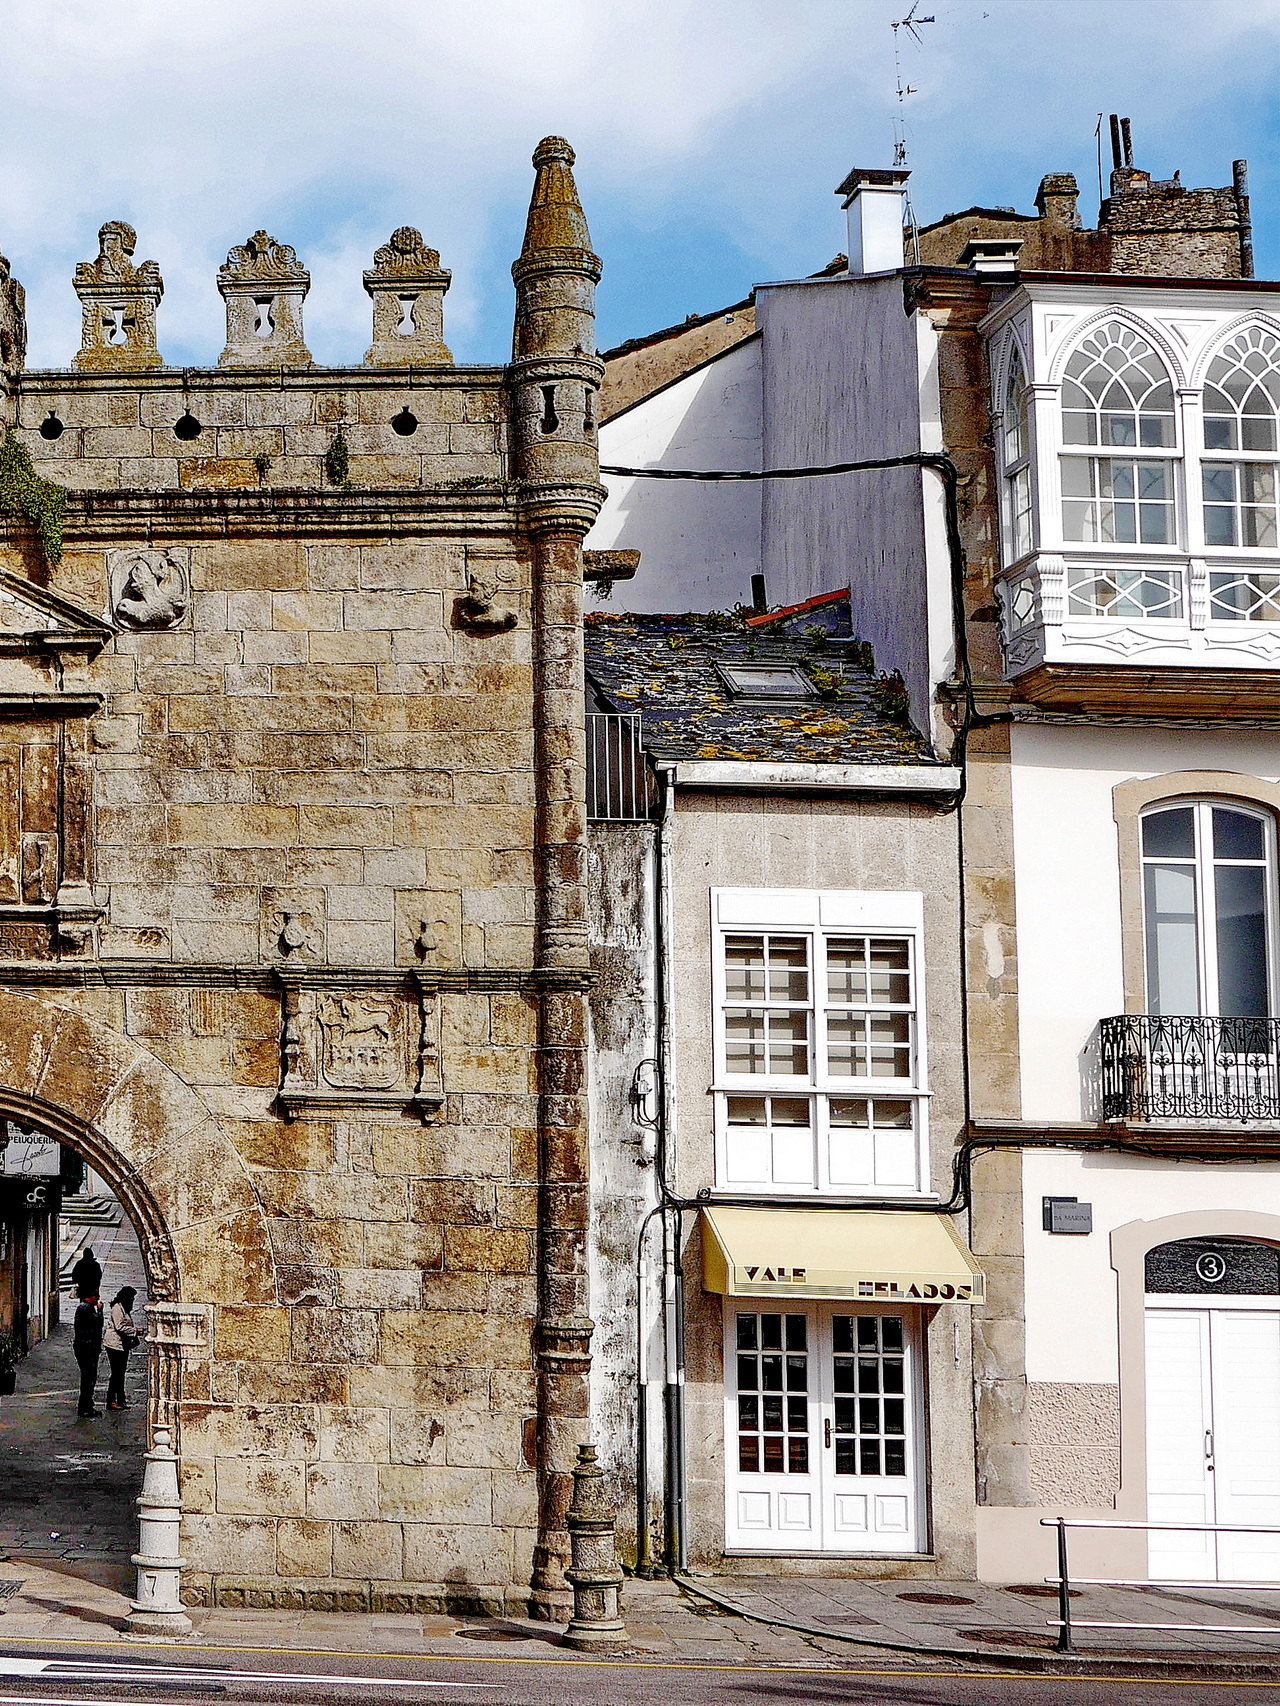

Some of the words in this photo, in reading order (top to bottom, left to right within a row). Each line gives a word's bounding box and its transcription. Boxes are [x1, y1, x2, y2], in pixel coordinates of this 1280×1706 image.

[743, 1266, 807, 1283] VALE
[1204, 1257, 1218, 1277] 3
[857, 1281, 972, 1301] HELADOS
